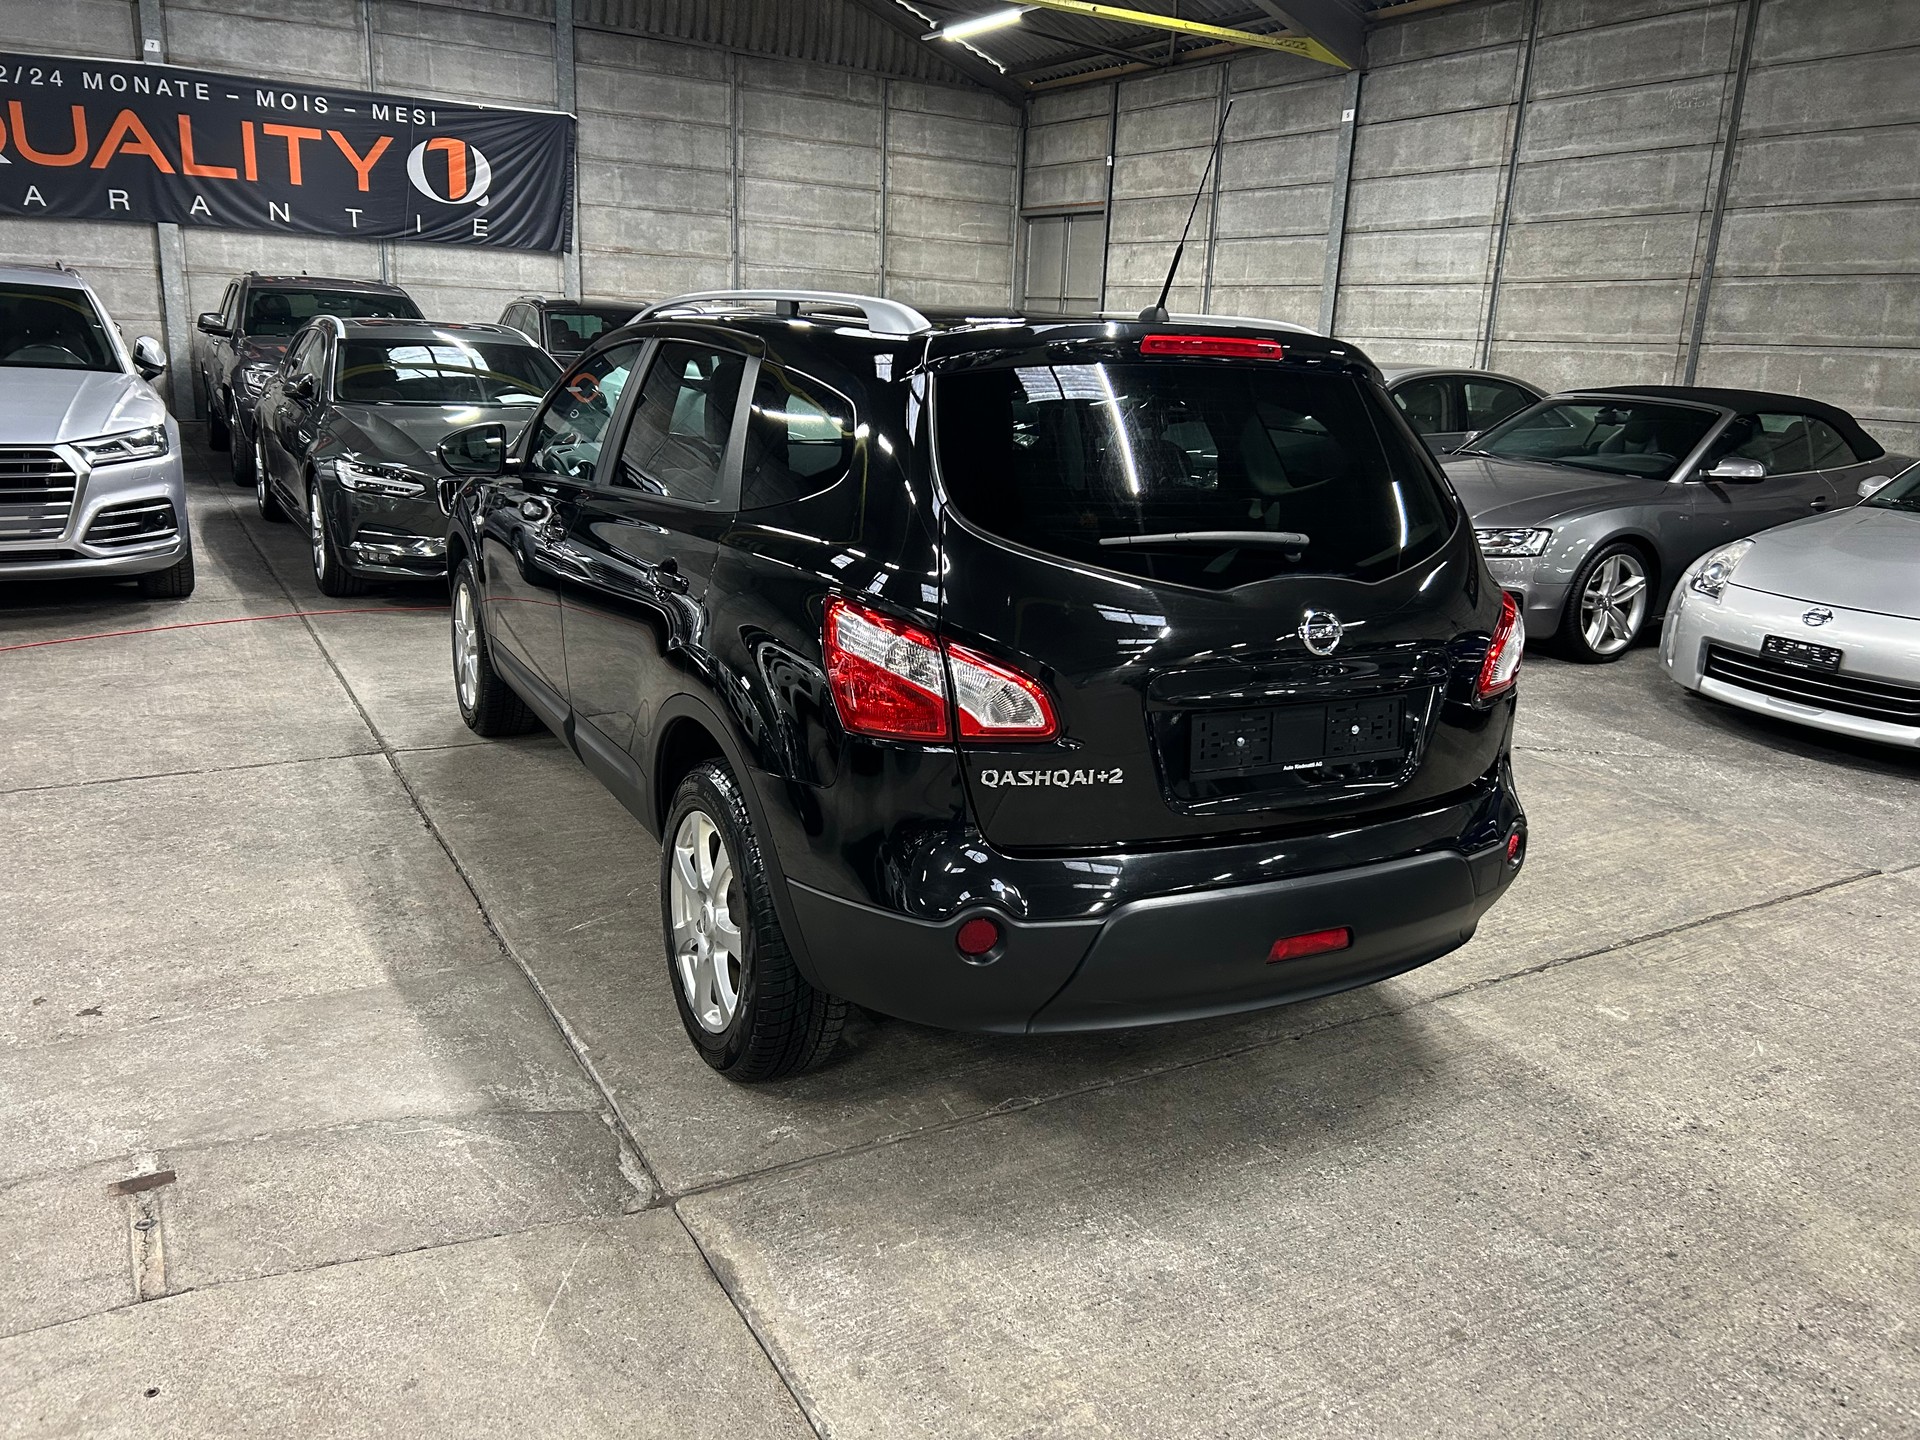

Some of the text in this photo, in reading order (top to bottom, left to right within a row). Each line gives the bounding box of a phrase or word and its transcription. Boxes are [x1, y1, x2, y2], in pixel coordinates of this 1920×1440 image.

[82, 71, 210, 100] MONATE
[256, 89, 329, 114] MOIS
[372, 103, 437, 126] MESI
[980, 767, 1124, 788] QASHQAI+2
